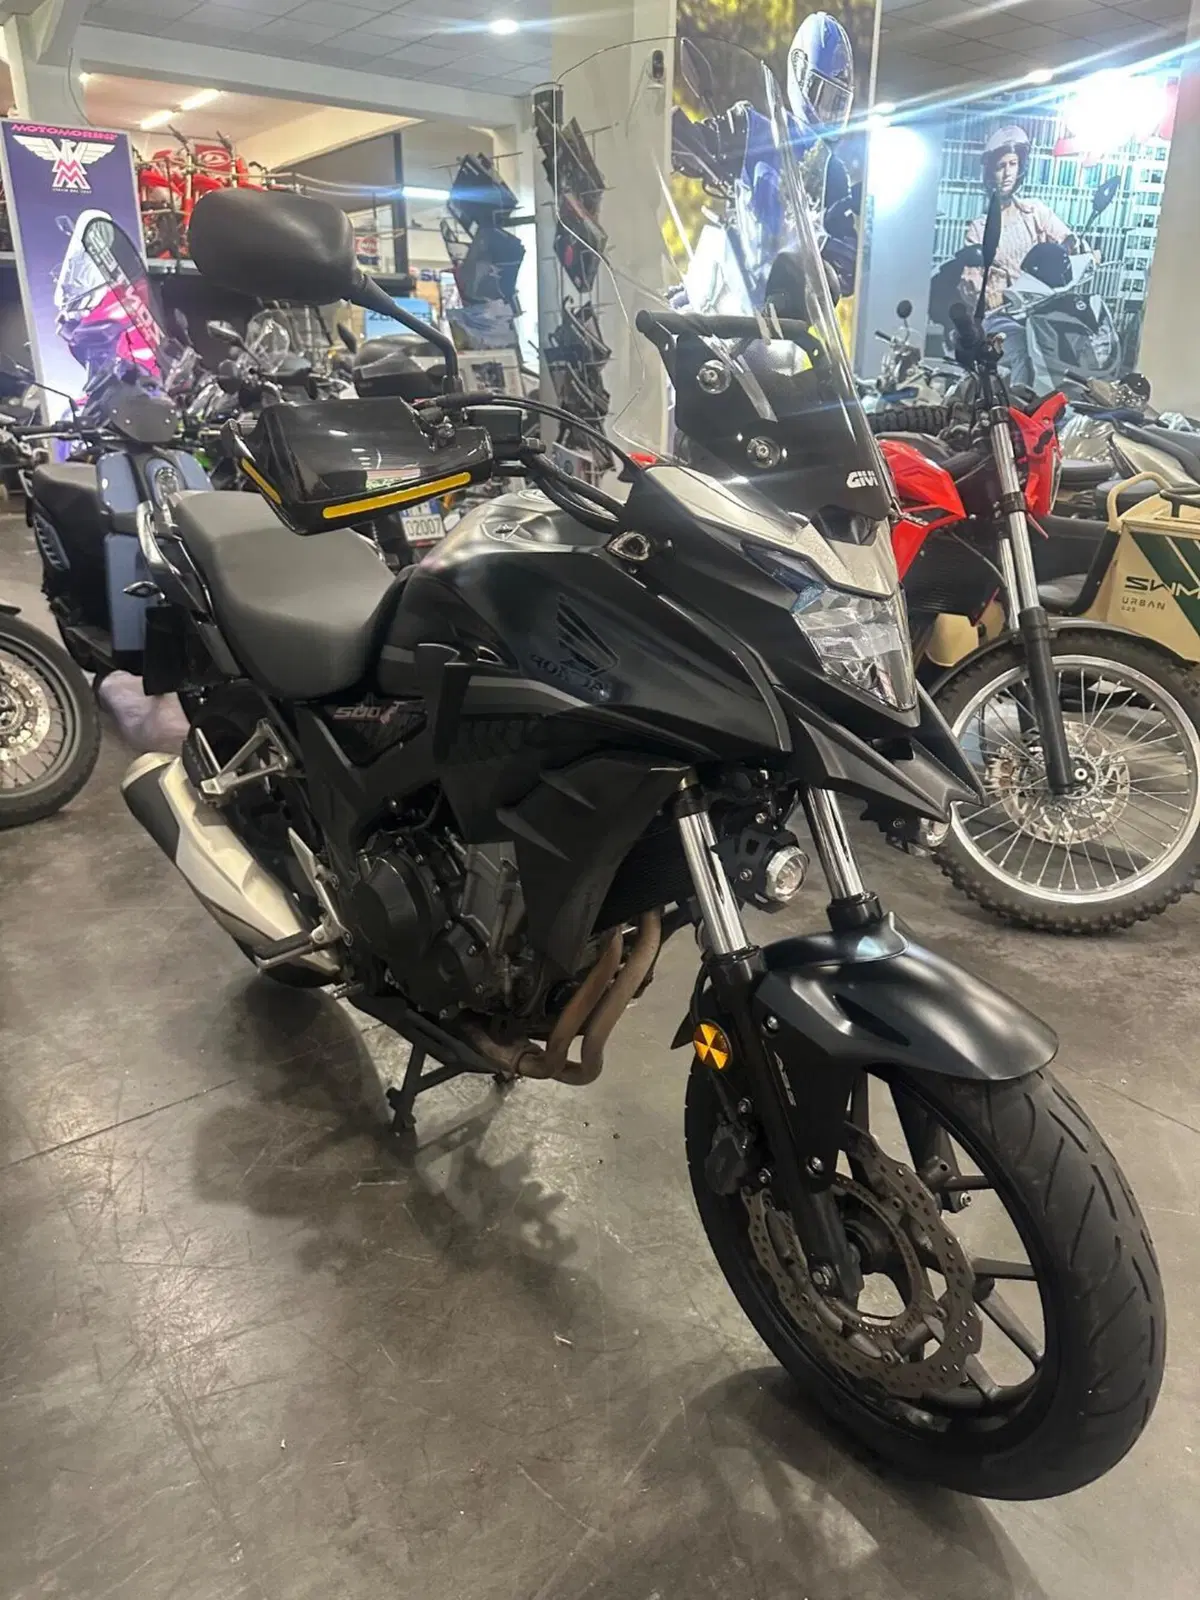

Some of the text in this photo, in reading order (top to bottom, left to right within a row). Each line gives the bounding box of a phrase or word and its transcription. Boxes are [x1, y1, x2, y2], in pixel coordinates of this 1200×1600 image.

[846, 470, 879, 488] GIVI
[1124, 576, 1200, 600] SWM
[1122, 596, 1166, 610] URBAN
